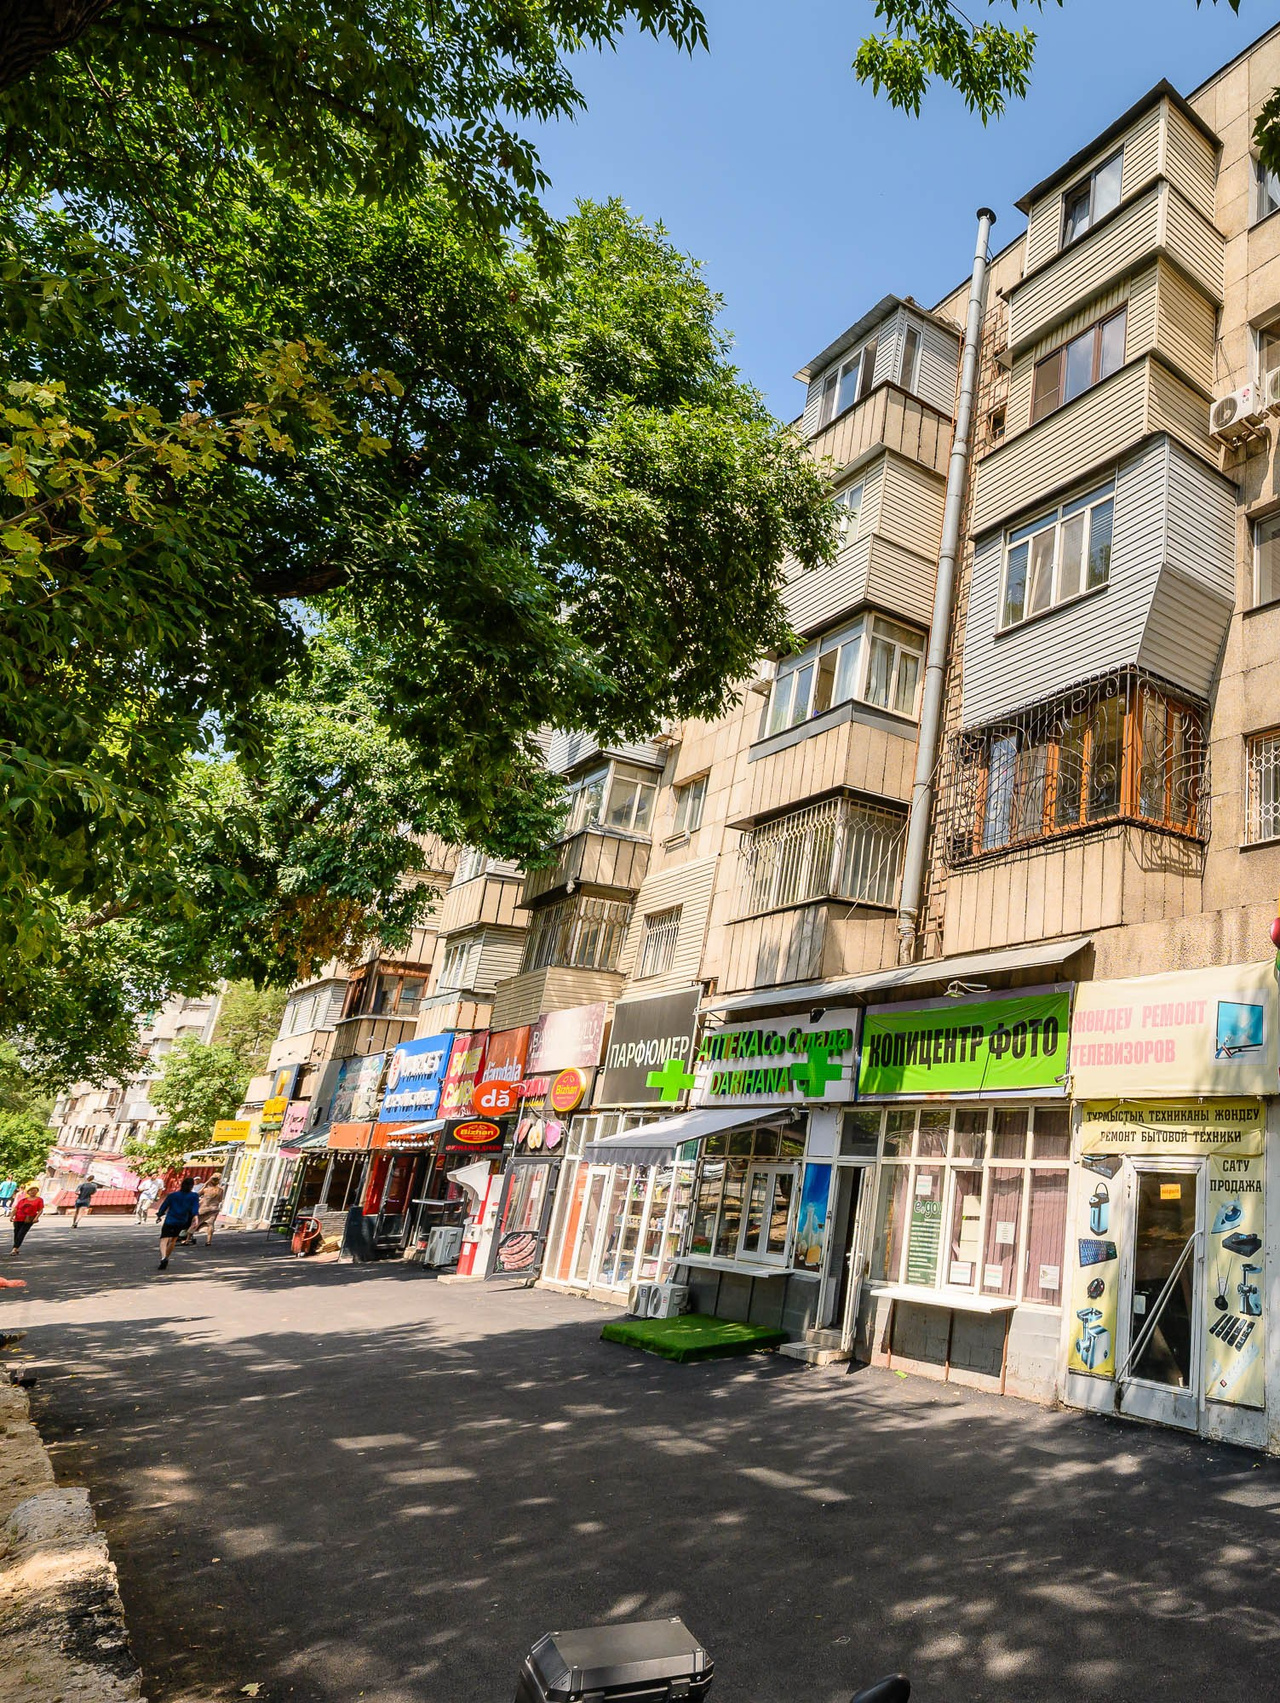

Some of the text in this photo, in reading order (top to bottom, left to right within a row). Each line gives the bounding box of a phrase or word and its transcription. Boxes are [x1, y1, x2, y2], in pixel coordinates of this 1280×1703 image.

[1073, 999, 1207, 1034] ЖӨНДЕУ РЕМОНТ
[609, 1035, 690, 1069] ПАРФЮМЕР
[697, 1029, 759, 1062] АПТЕКА
[785, 1027, 853, 1057] Склада
[869, 1016, 1059, 1070] КОПИЦЕНТР ФОТО
[1073, 1039, 1175, 1067] ТЕЛЕВИЗОРОВ
[555, 1084, 578, 1095] Bizhan
[709, 1066, 791, 1095] DARIHANA
[1148, 1109, 1209, 1122] ТЕХНИКАНЫ
[1214, 1108, 1260, 1123] ЖӨНДЕУ
[460, 1128, 494, 1137] Bizhan
[1100, 1128, 1242, 1143] РЕМОНТ БЫТОВОЙ ТЕХНИКИ
[1222, 1160, 1250, 1173] САТУ
[1210, 1178, 1263, 1194] ПРОДАЖА
[914, 1200, 942, 1219] e.go
